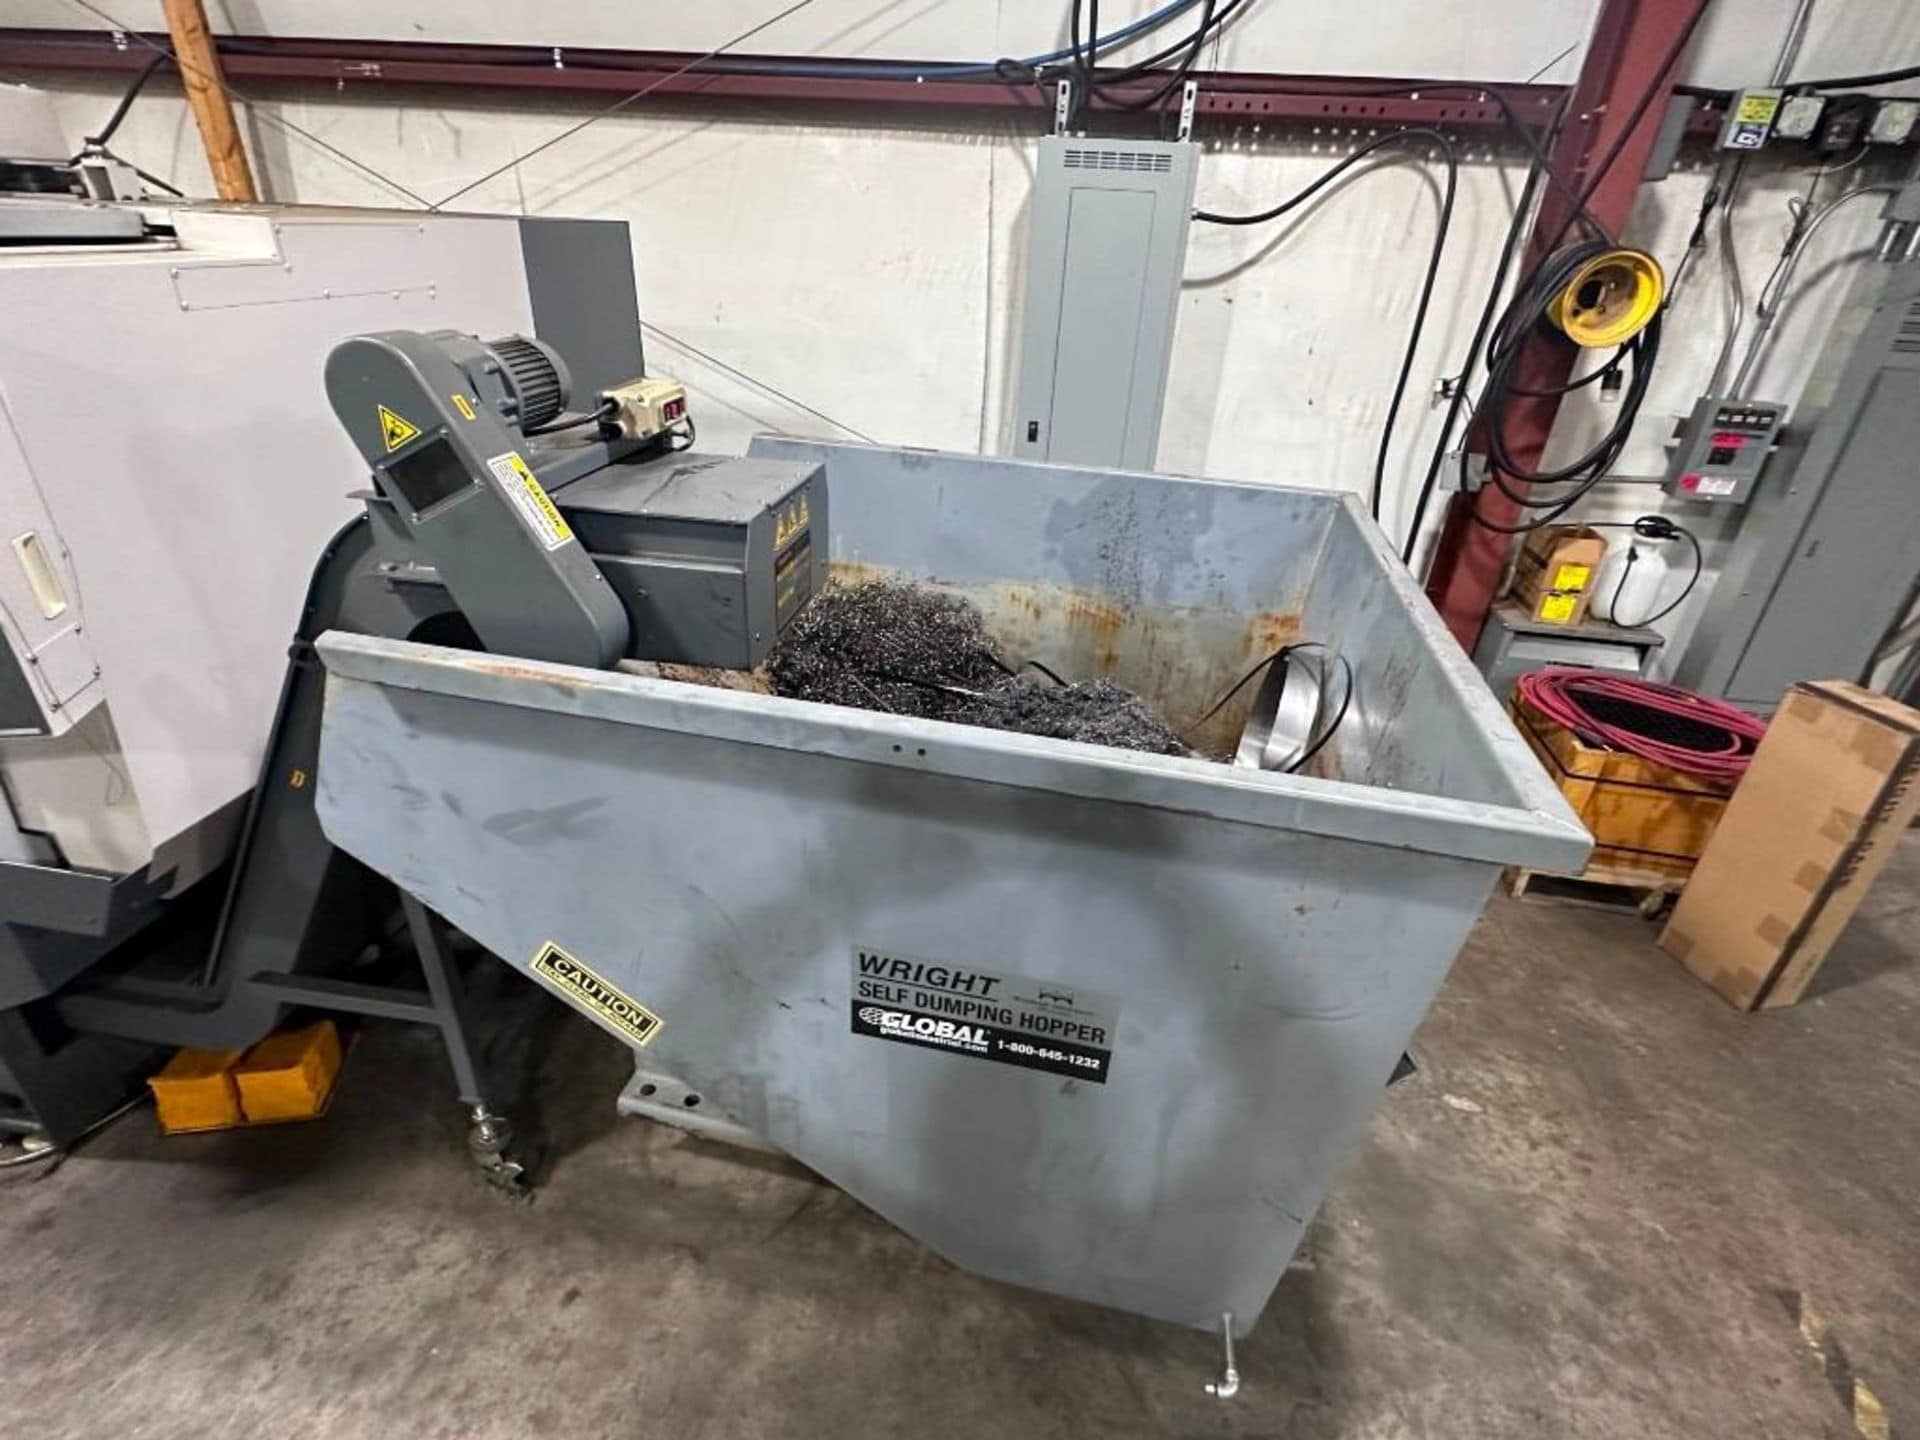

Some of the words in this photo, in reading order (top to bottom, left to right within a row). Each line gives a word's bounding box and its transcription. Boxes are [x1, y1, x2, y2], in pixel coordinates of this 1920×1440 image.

[529, 483, 561, 527] CAUTION
[554, 958, 645, 1026] CAUTION
[858, 952, 1001, 996] WRIGHT
[859, 980, 908, 1003] SELF
[915, 991, 1013, 1026] DUMPING
[1019, 1010, 1107, 1045] HOPPER
[881, 1011, 990, 1046] GLOBAL
